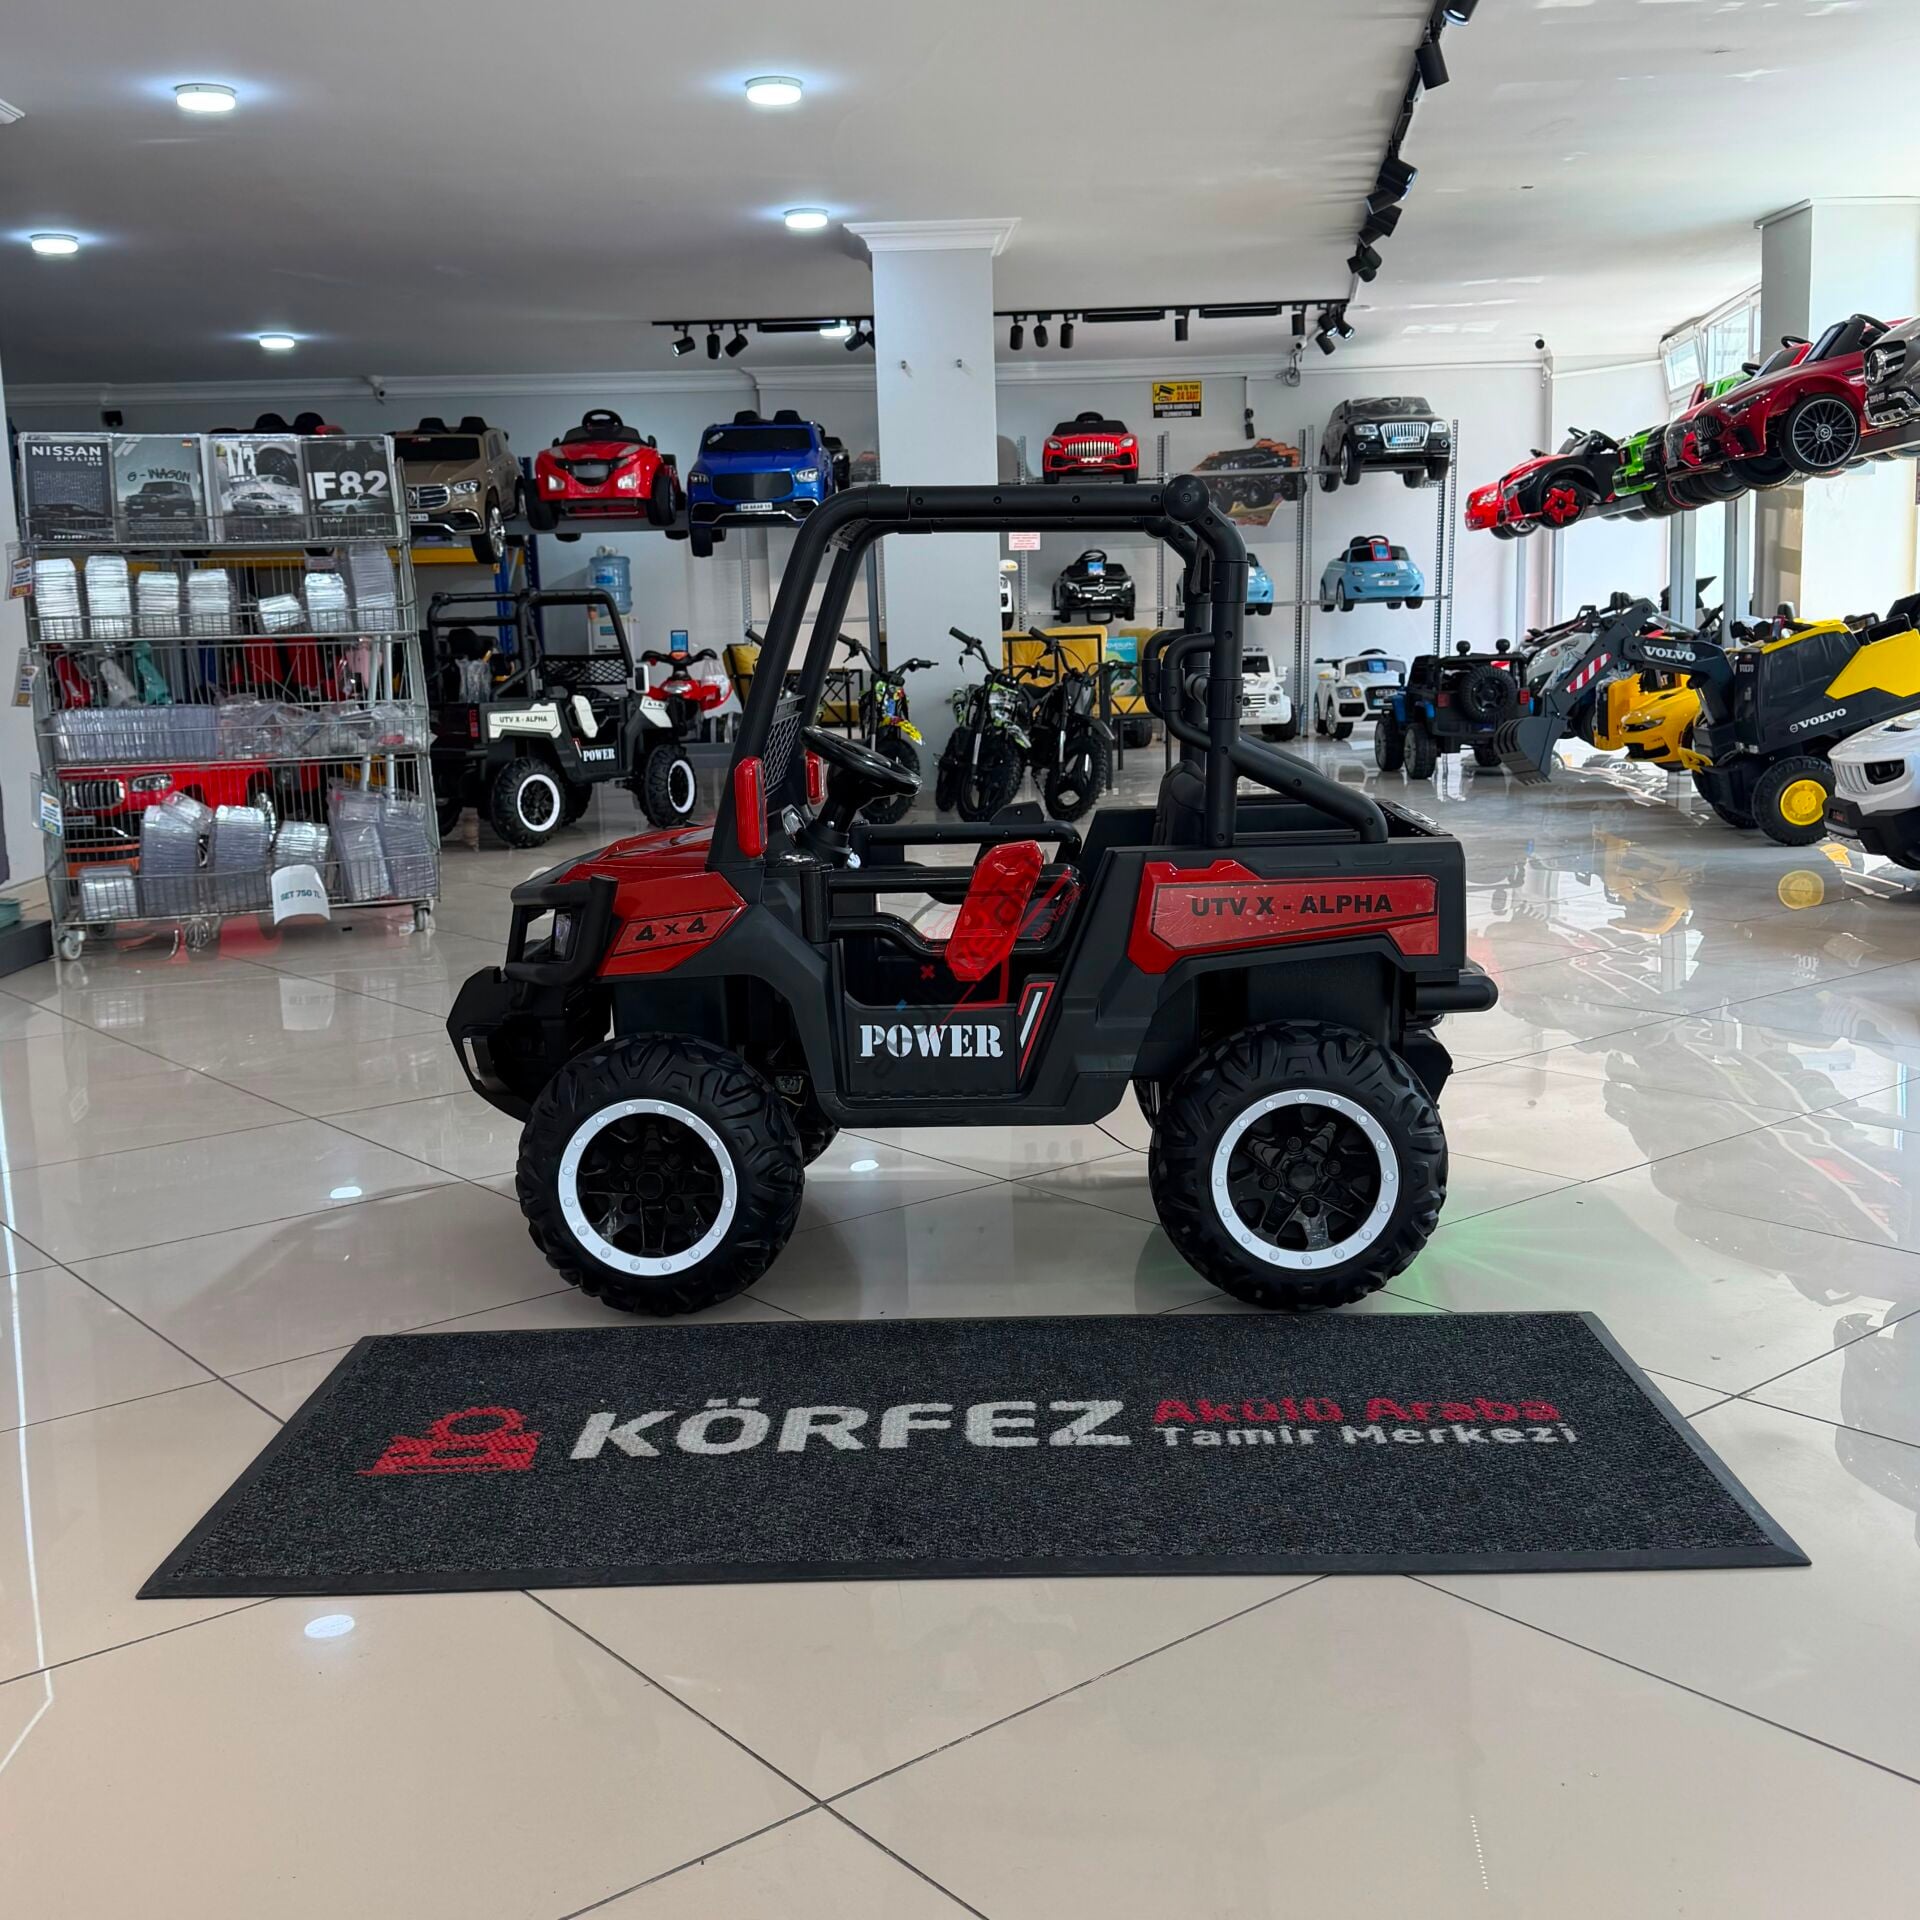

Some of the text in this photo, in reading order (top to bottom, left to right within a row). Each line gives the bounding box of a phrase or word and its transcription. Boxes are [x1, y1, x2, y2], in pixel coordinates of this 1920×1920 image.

[31, 446, 101, 456] NISSAN
[1643, 645, 1696, 661] VOLVO
[1797, 708, 1847, 728] VOLVO
[583, 748, 615, 762] POWER
[1191, 896, 1247, 917] UTV
[1255, 896, 1275, 915] X
[1299, 894, 1393, 915] ALPHA
[859, 1024, 1004, 1058] POWER
[1153, 1396, 1561, 1424] Akülü Araba
[569, 1397, 1132, 1460] KÖRFEZ
[1153, 1422, 1579, 1447] Tamir Merkezi
